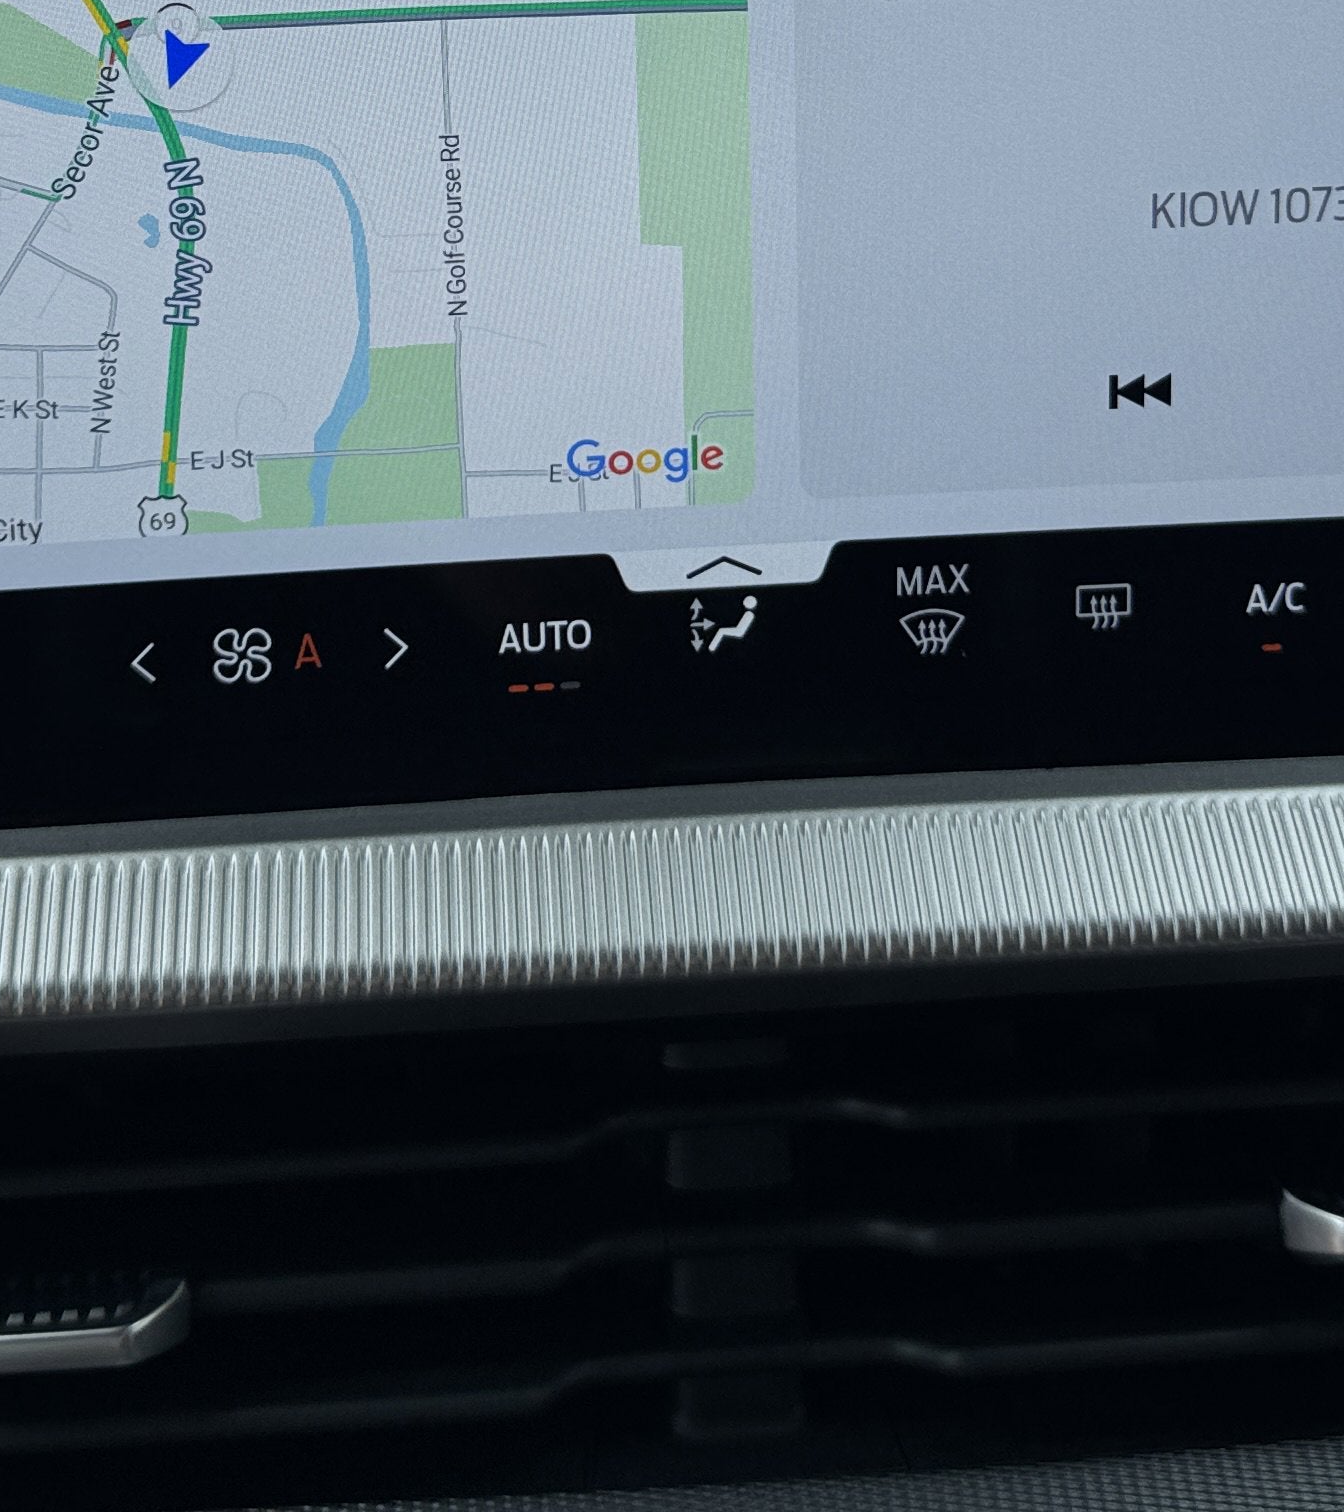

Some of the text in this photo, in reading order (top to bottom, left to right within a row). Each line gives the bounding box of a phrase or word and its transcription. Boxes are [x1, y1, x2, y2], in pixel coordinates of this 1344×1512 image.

[51, 65, 120, 200] Secor Ave
[438, 134, 469, 317] N Golf Course Rd
[1149, 189, 1260, 230] KIOW
[162, 157, 213, 326] Hwy 69 N
[89, 330, 121, 434] N West St
[12, 399, 29, 420] K
[35, 399, 60, 420] St
[190, 448, 255, 471] E J St
[549, 463, 563, 483] E
[566, 433, 725, 484] Google
[150, 511, 176, 531] 69
[895, 563, 970, 596] MAX
[1246, 581, 1308, 615] A/C
[295, 633, 323, 670] A
[499, 619, 592, 655] AUTO
